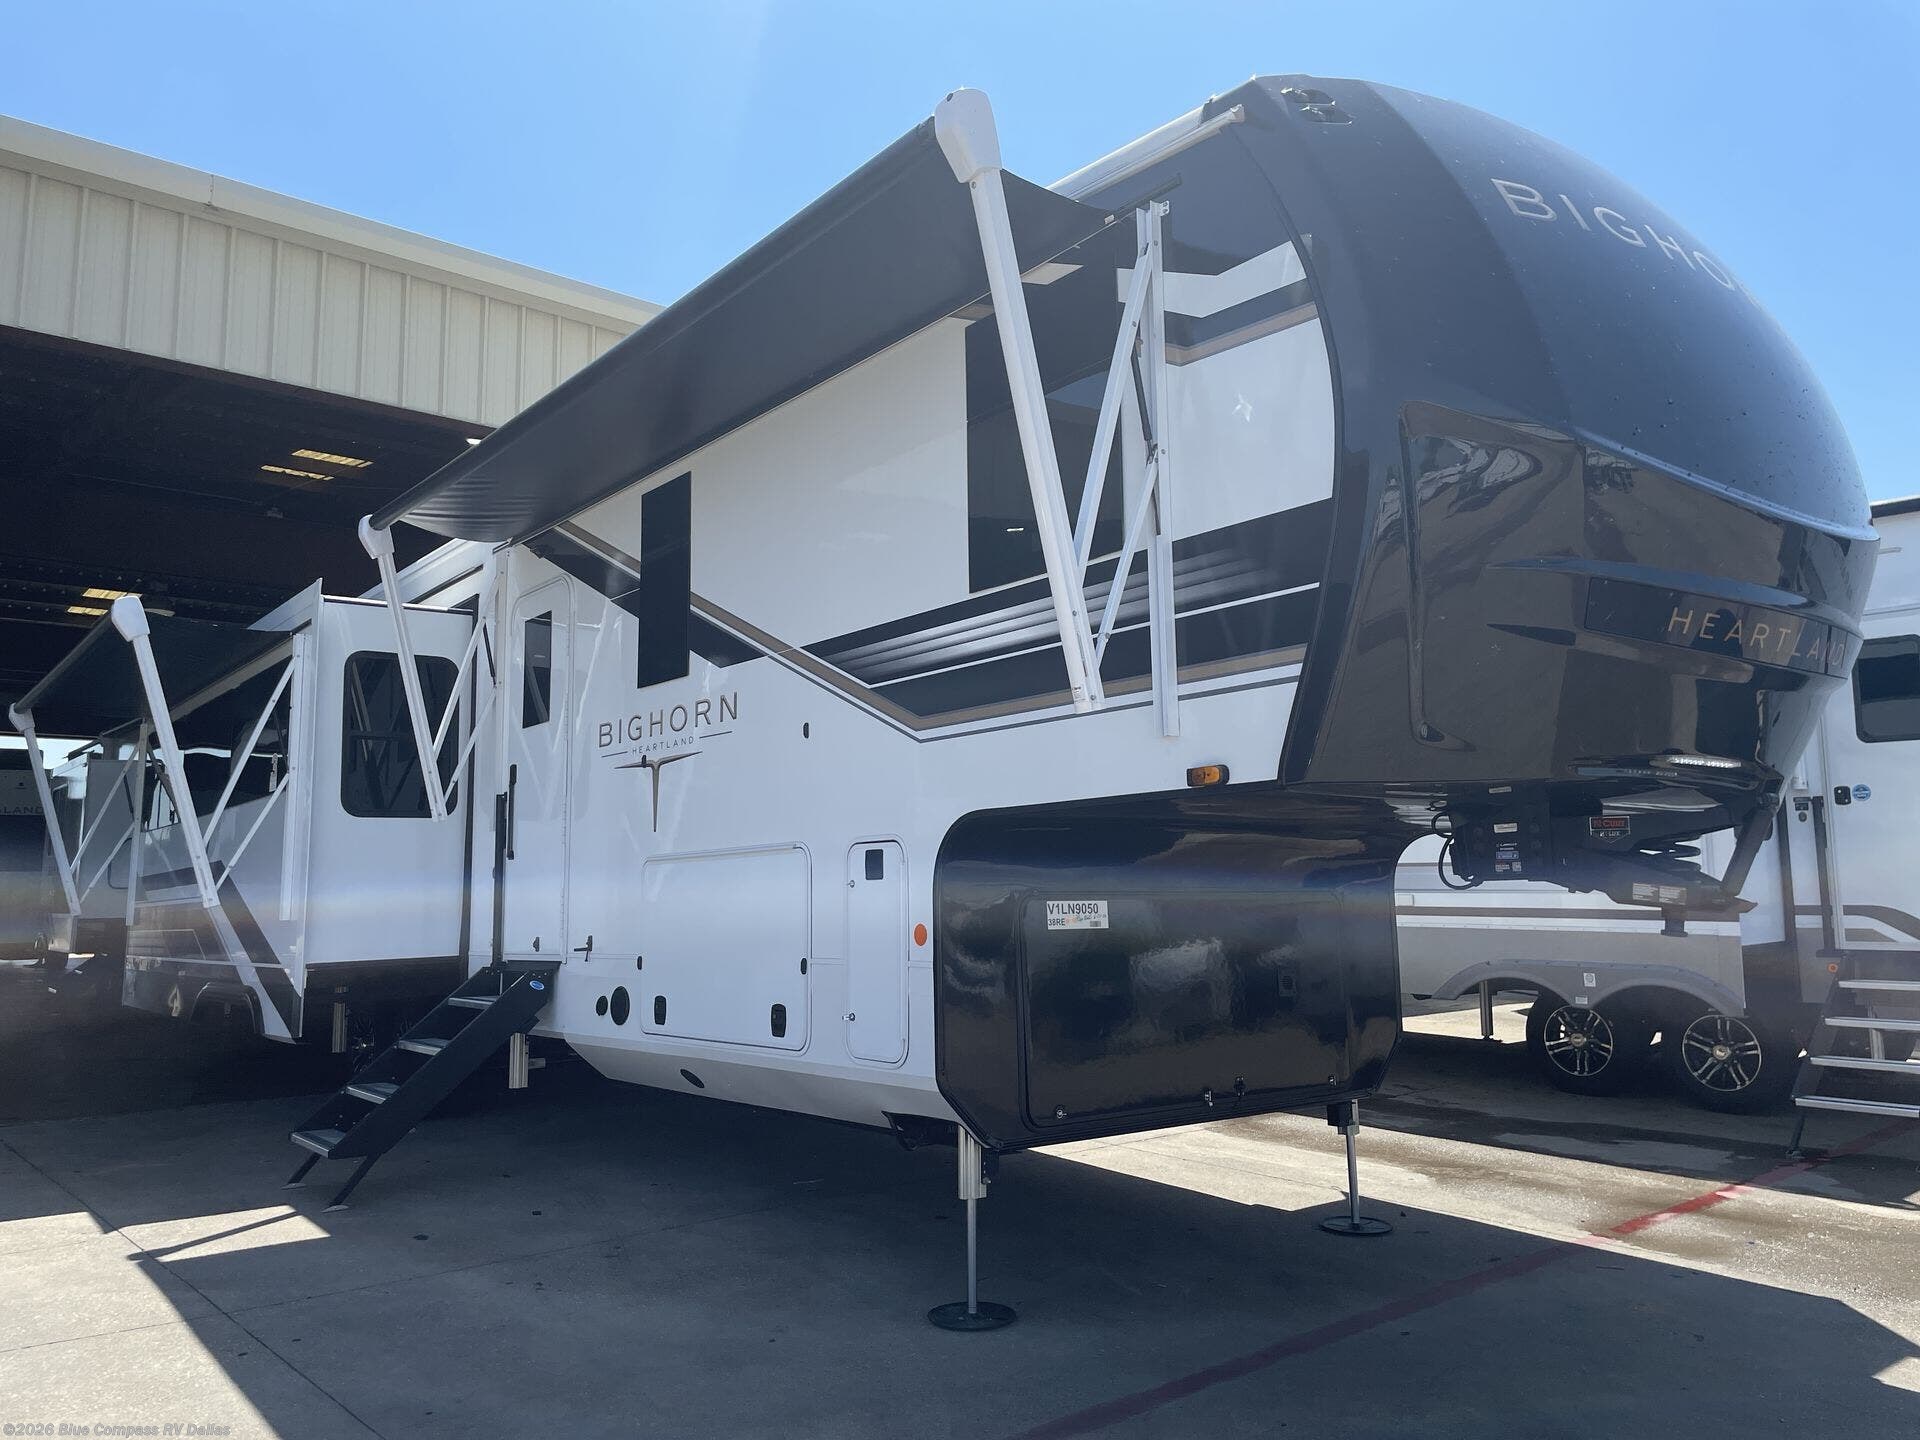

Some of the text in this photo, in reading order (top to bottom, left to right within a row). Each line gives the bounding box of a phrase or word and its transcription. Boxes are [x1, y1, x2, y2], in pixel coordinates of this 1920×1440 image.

[1490, 178, 1758, 304] BIGHO
[1667, 606, 1845, 667] HEARTLAND
[599, 691, 738, 748] BIGHORN
[631, 735, 695, 755] HEARTLAND
[1047, 903, 1099, 915] V1LN9050
